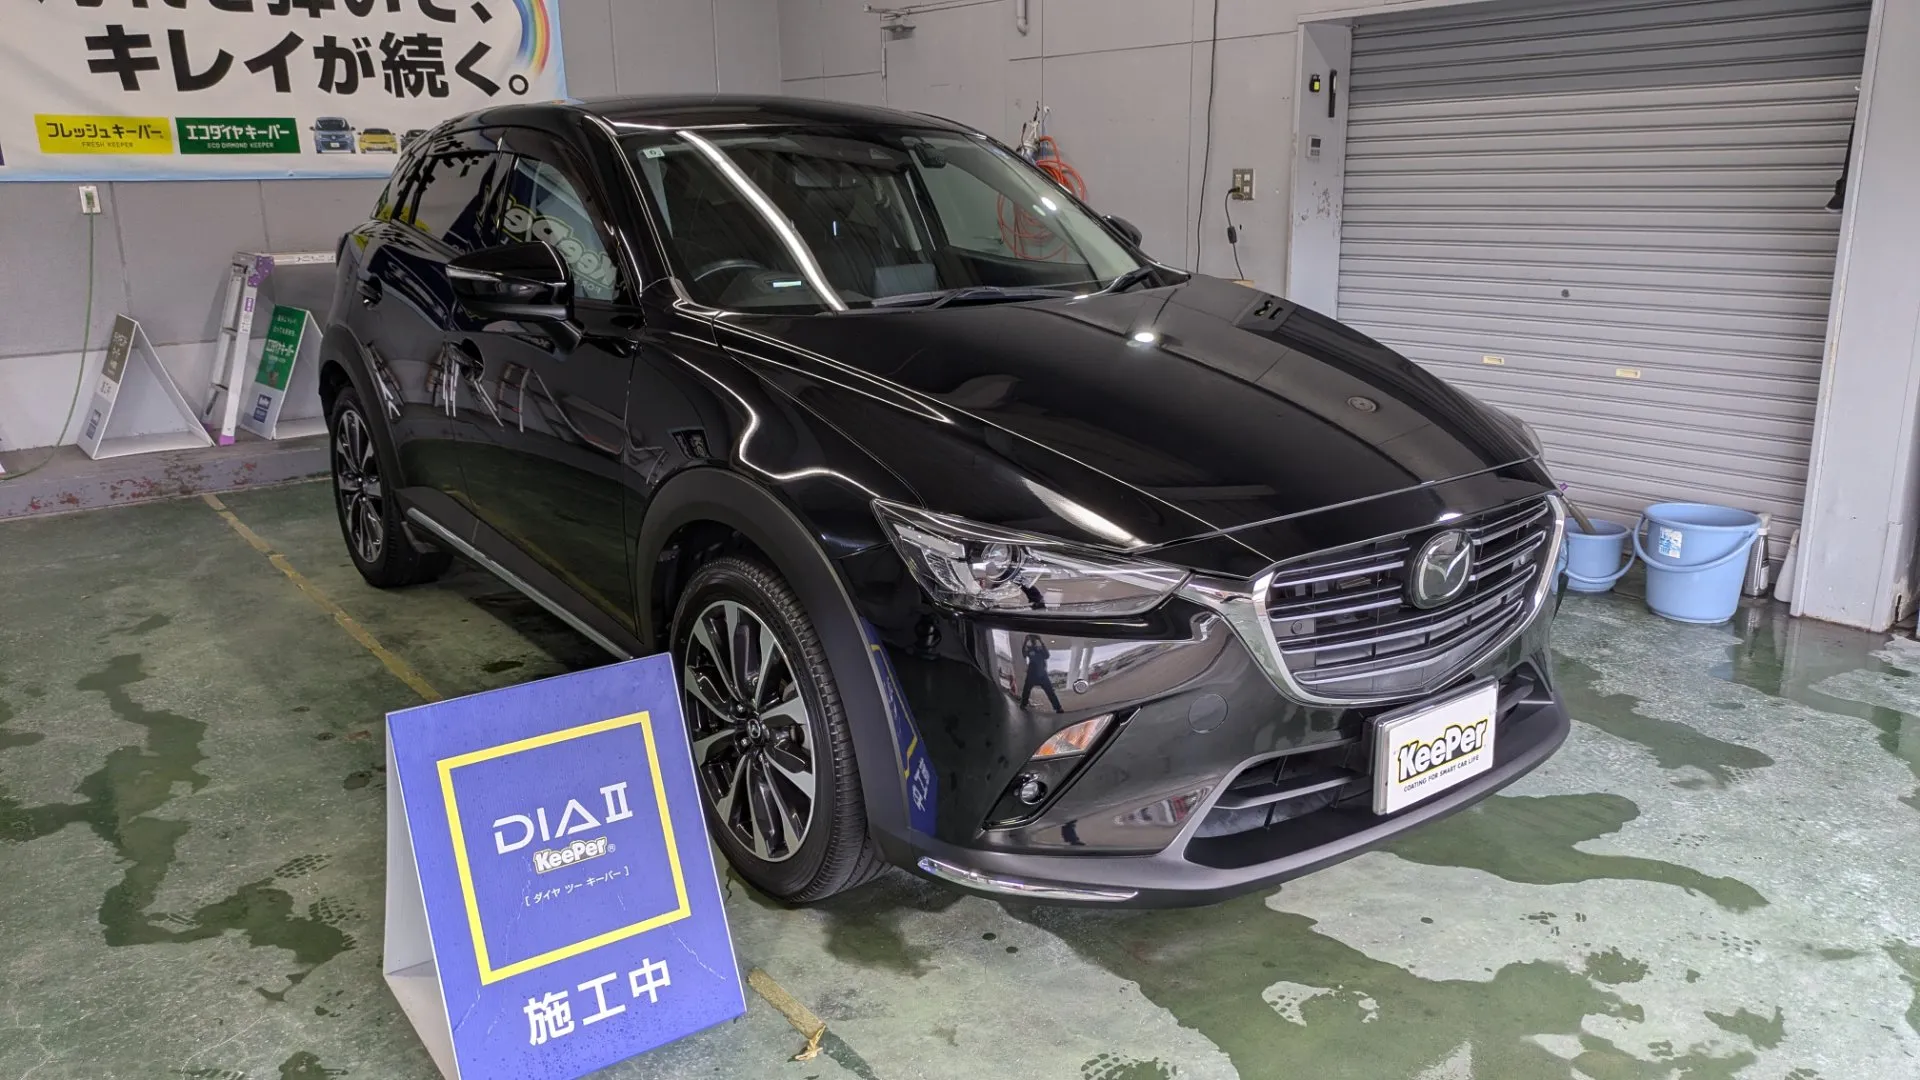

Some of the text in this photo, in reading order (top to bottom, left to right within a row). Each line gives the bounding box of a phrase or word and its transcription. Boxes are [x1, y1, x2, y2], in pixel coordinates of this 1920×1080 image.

[84, 24, 530, 98] キレイが続く。
[187, 124, 291, 141] エコダイヤキーパー
[1397, 718, 1488, 784] KeePer
[1403, 754, 1479, 792] COATING FOR SMART CAR LIFE
[523, 957, 672, 1047] 施工中
